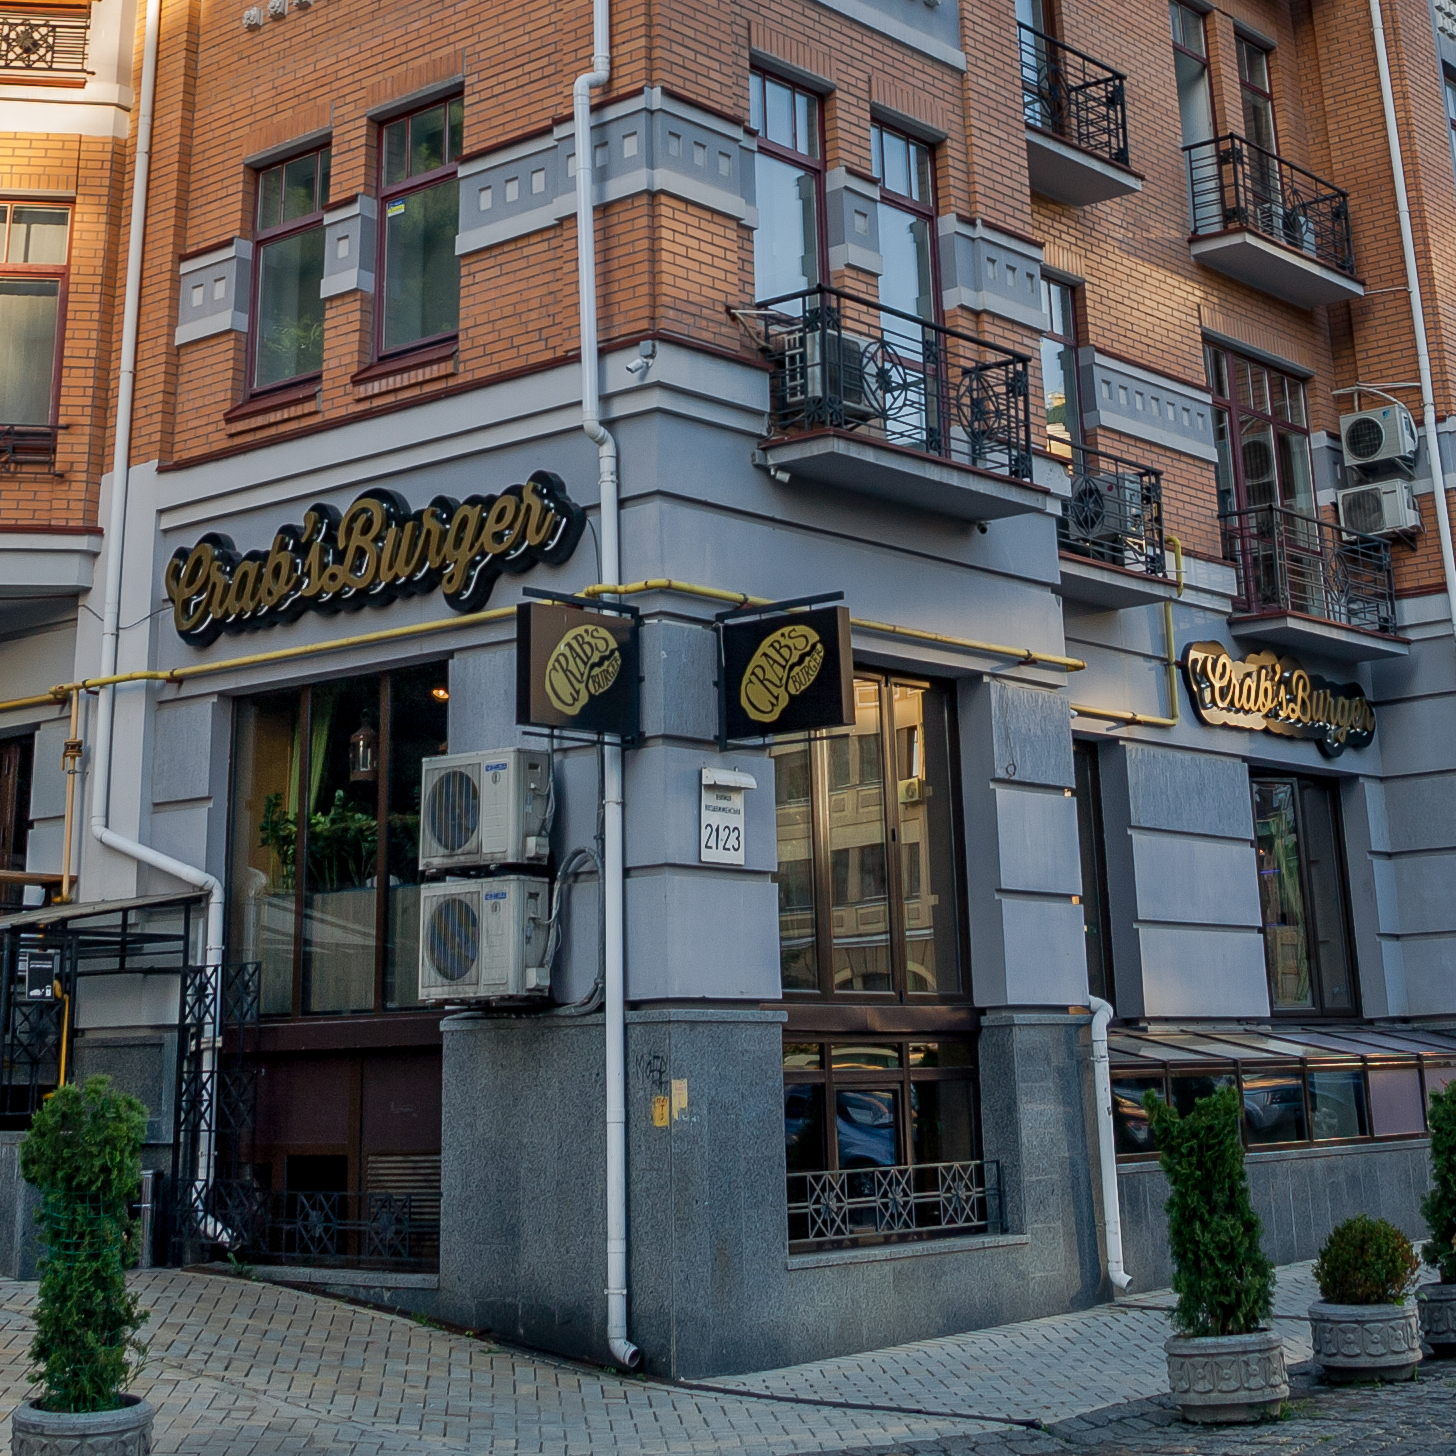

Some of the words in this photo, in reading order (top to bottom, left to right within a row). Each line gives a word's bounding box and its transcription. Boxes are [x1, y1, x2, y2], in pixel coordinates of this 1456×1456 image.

[165, 510, 323, 632] Crab's
[324, 481, 557, 595] Burger
[548, 627, 611, 708] CRAB'S
[589, 654, 621, 695] BURGER
[744, 628, 811, 715] CRAB'S
[790, 645, 824, 694] BURGER
[1206, 653, 1287, 718] Crab's
[1288, 669, 1376, 743] Burger
